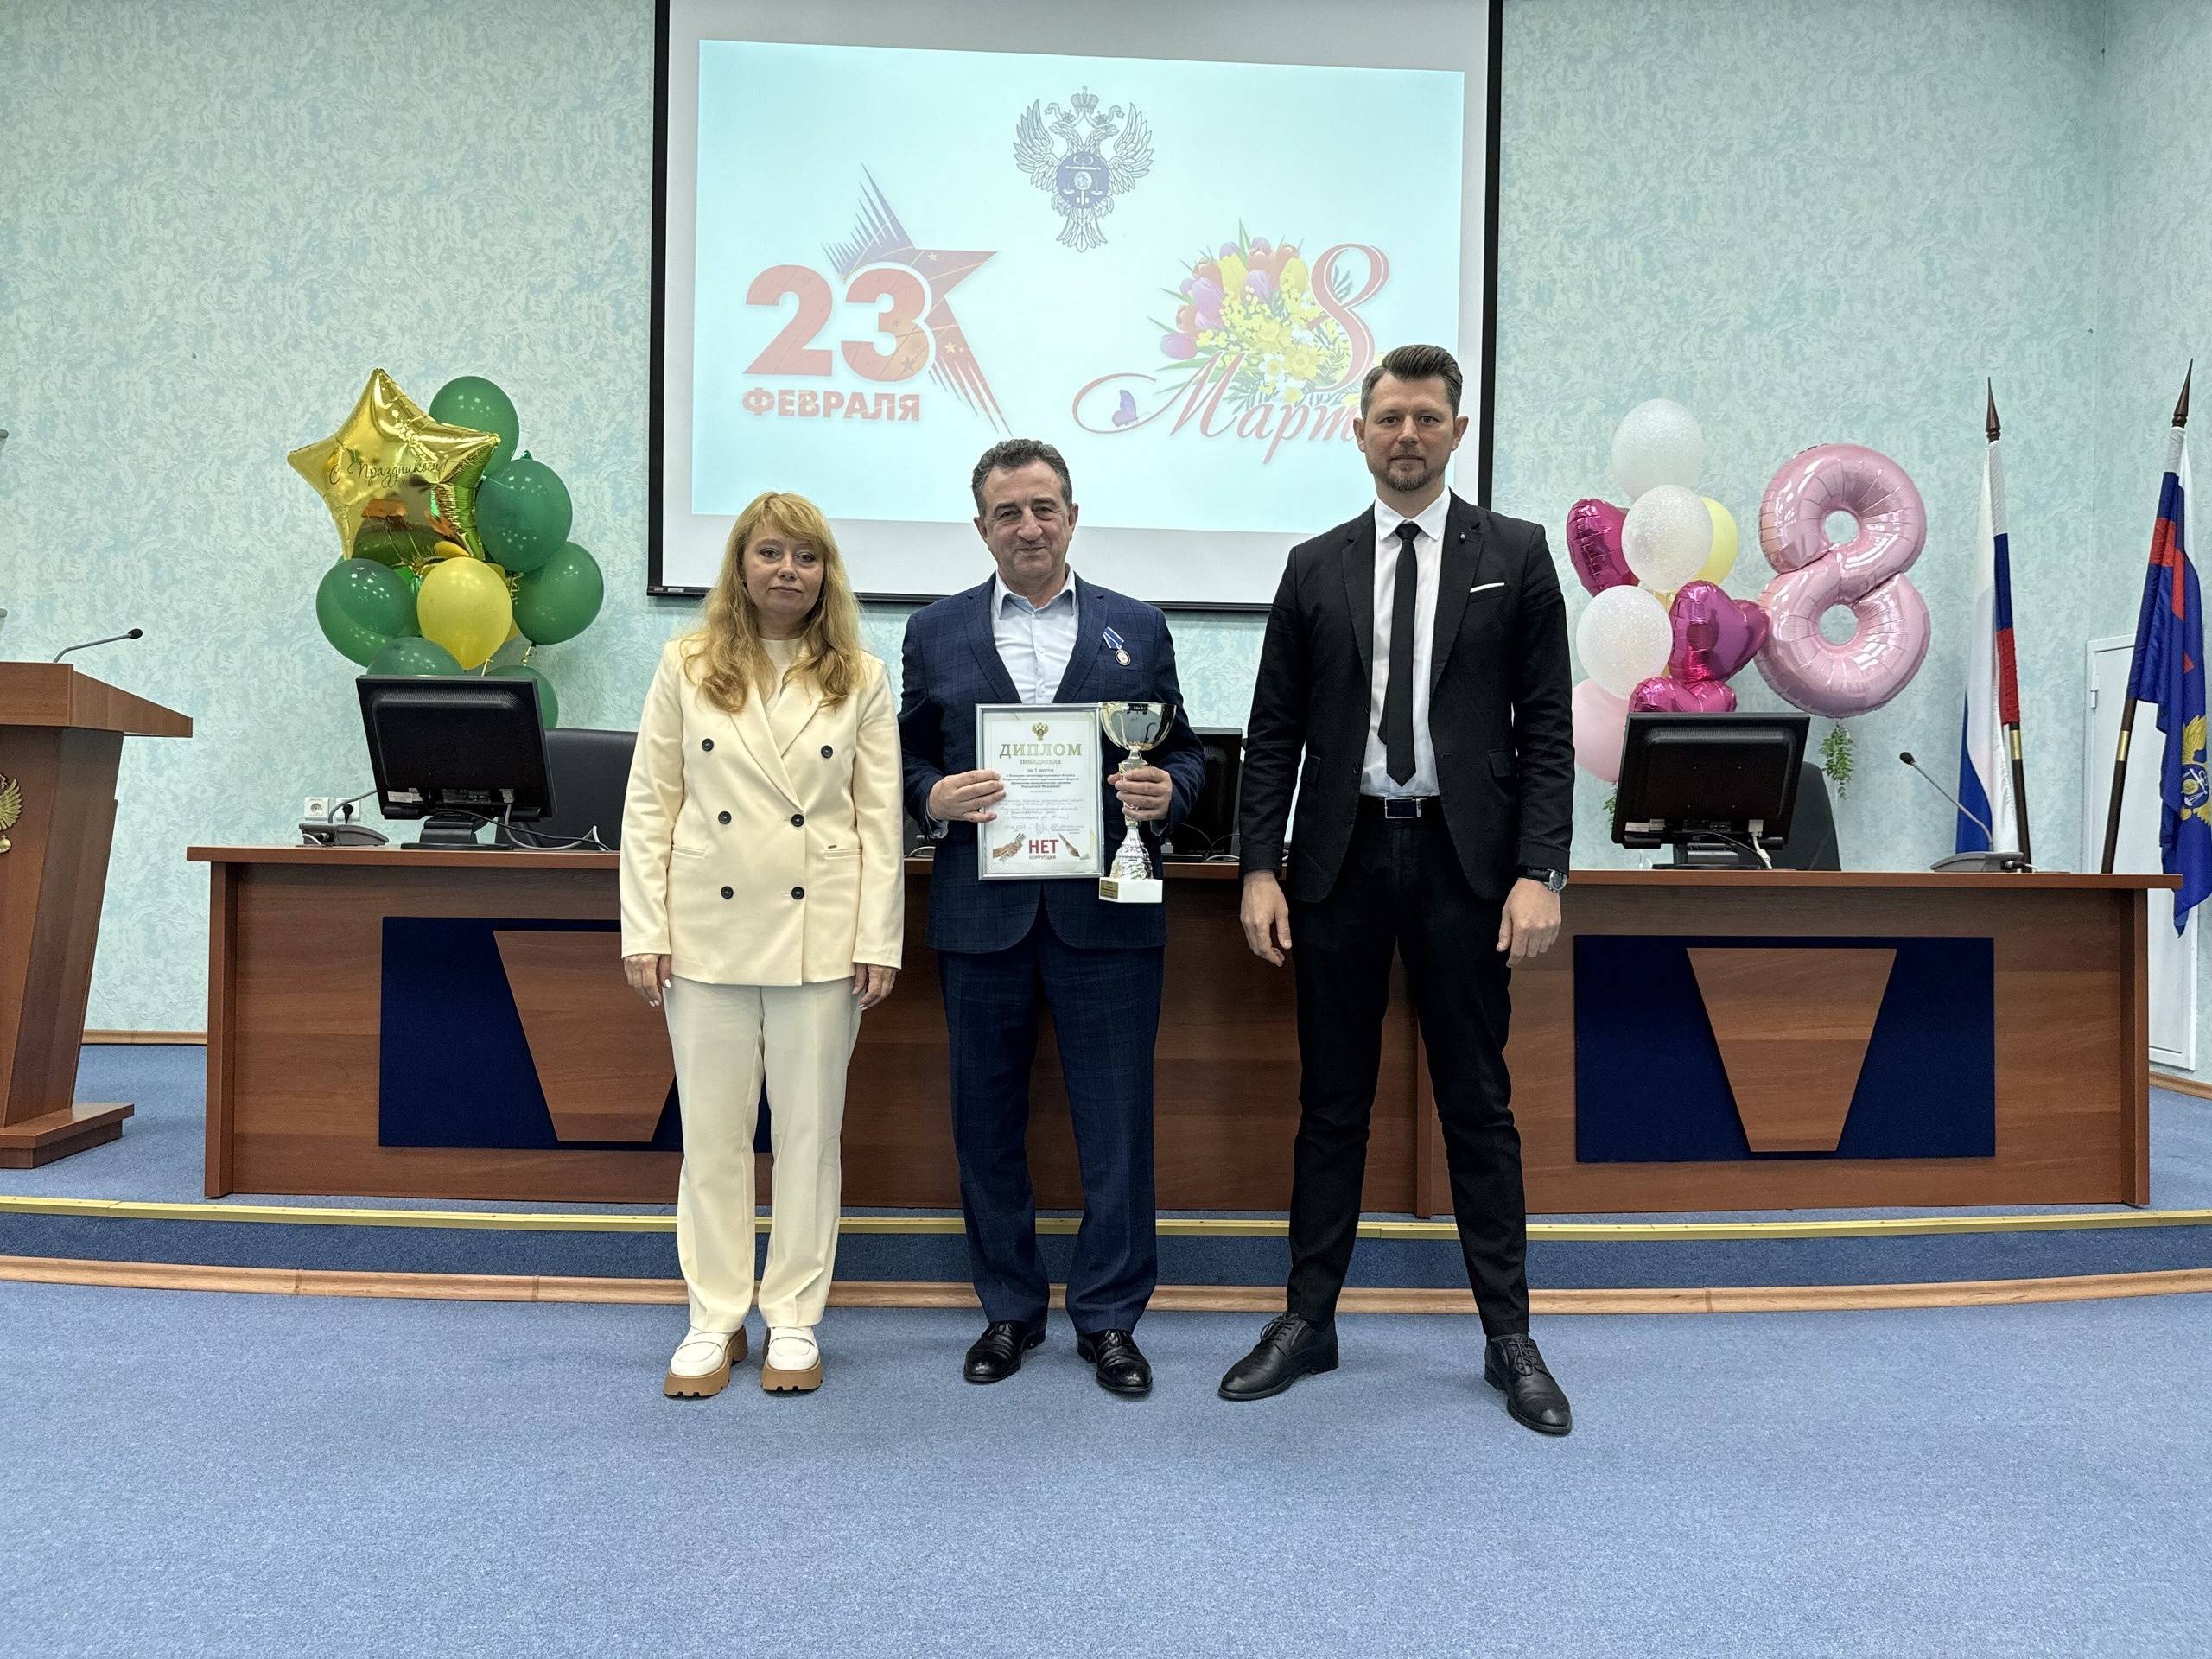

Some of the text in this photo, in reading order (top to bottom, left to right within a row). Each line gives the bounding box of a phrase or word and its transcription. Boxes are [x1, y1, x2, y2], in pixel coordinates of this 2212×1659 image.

[742, 264, 930, 382] 23
[1306, 242, 1390, 391] 8
[741, 387, 920, 422] ФЕВРАЛЯ
[1072, 349, 1359, 465] Март
[1753, 443, 1931, 719] 8
[999, 743, 1083, 759] ДИПЛОМ
[1028, 839, 1059, 854] НЕТ
